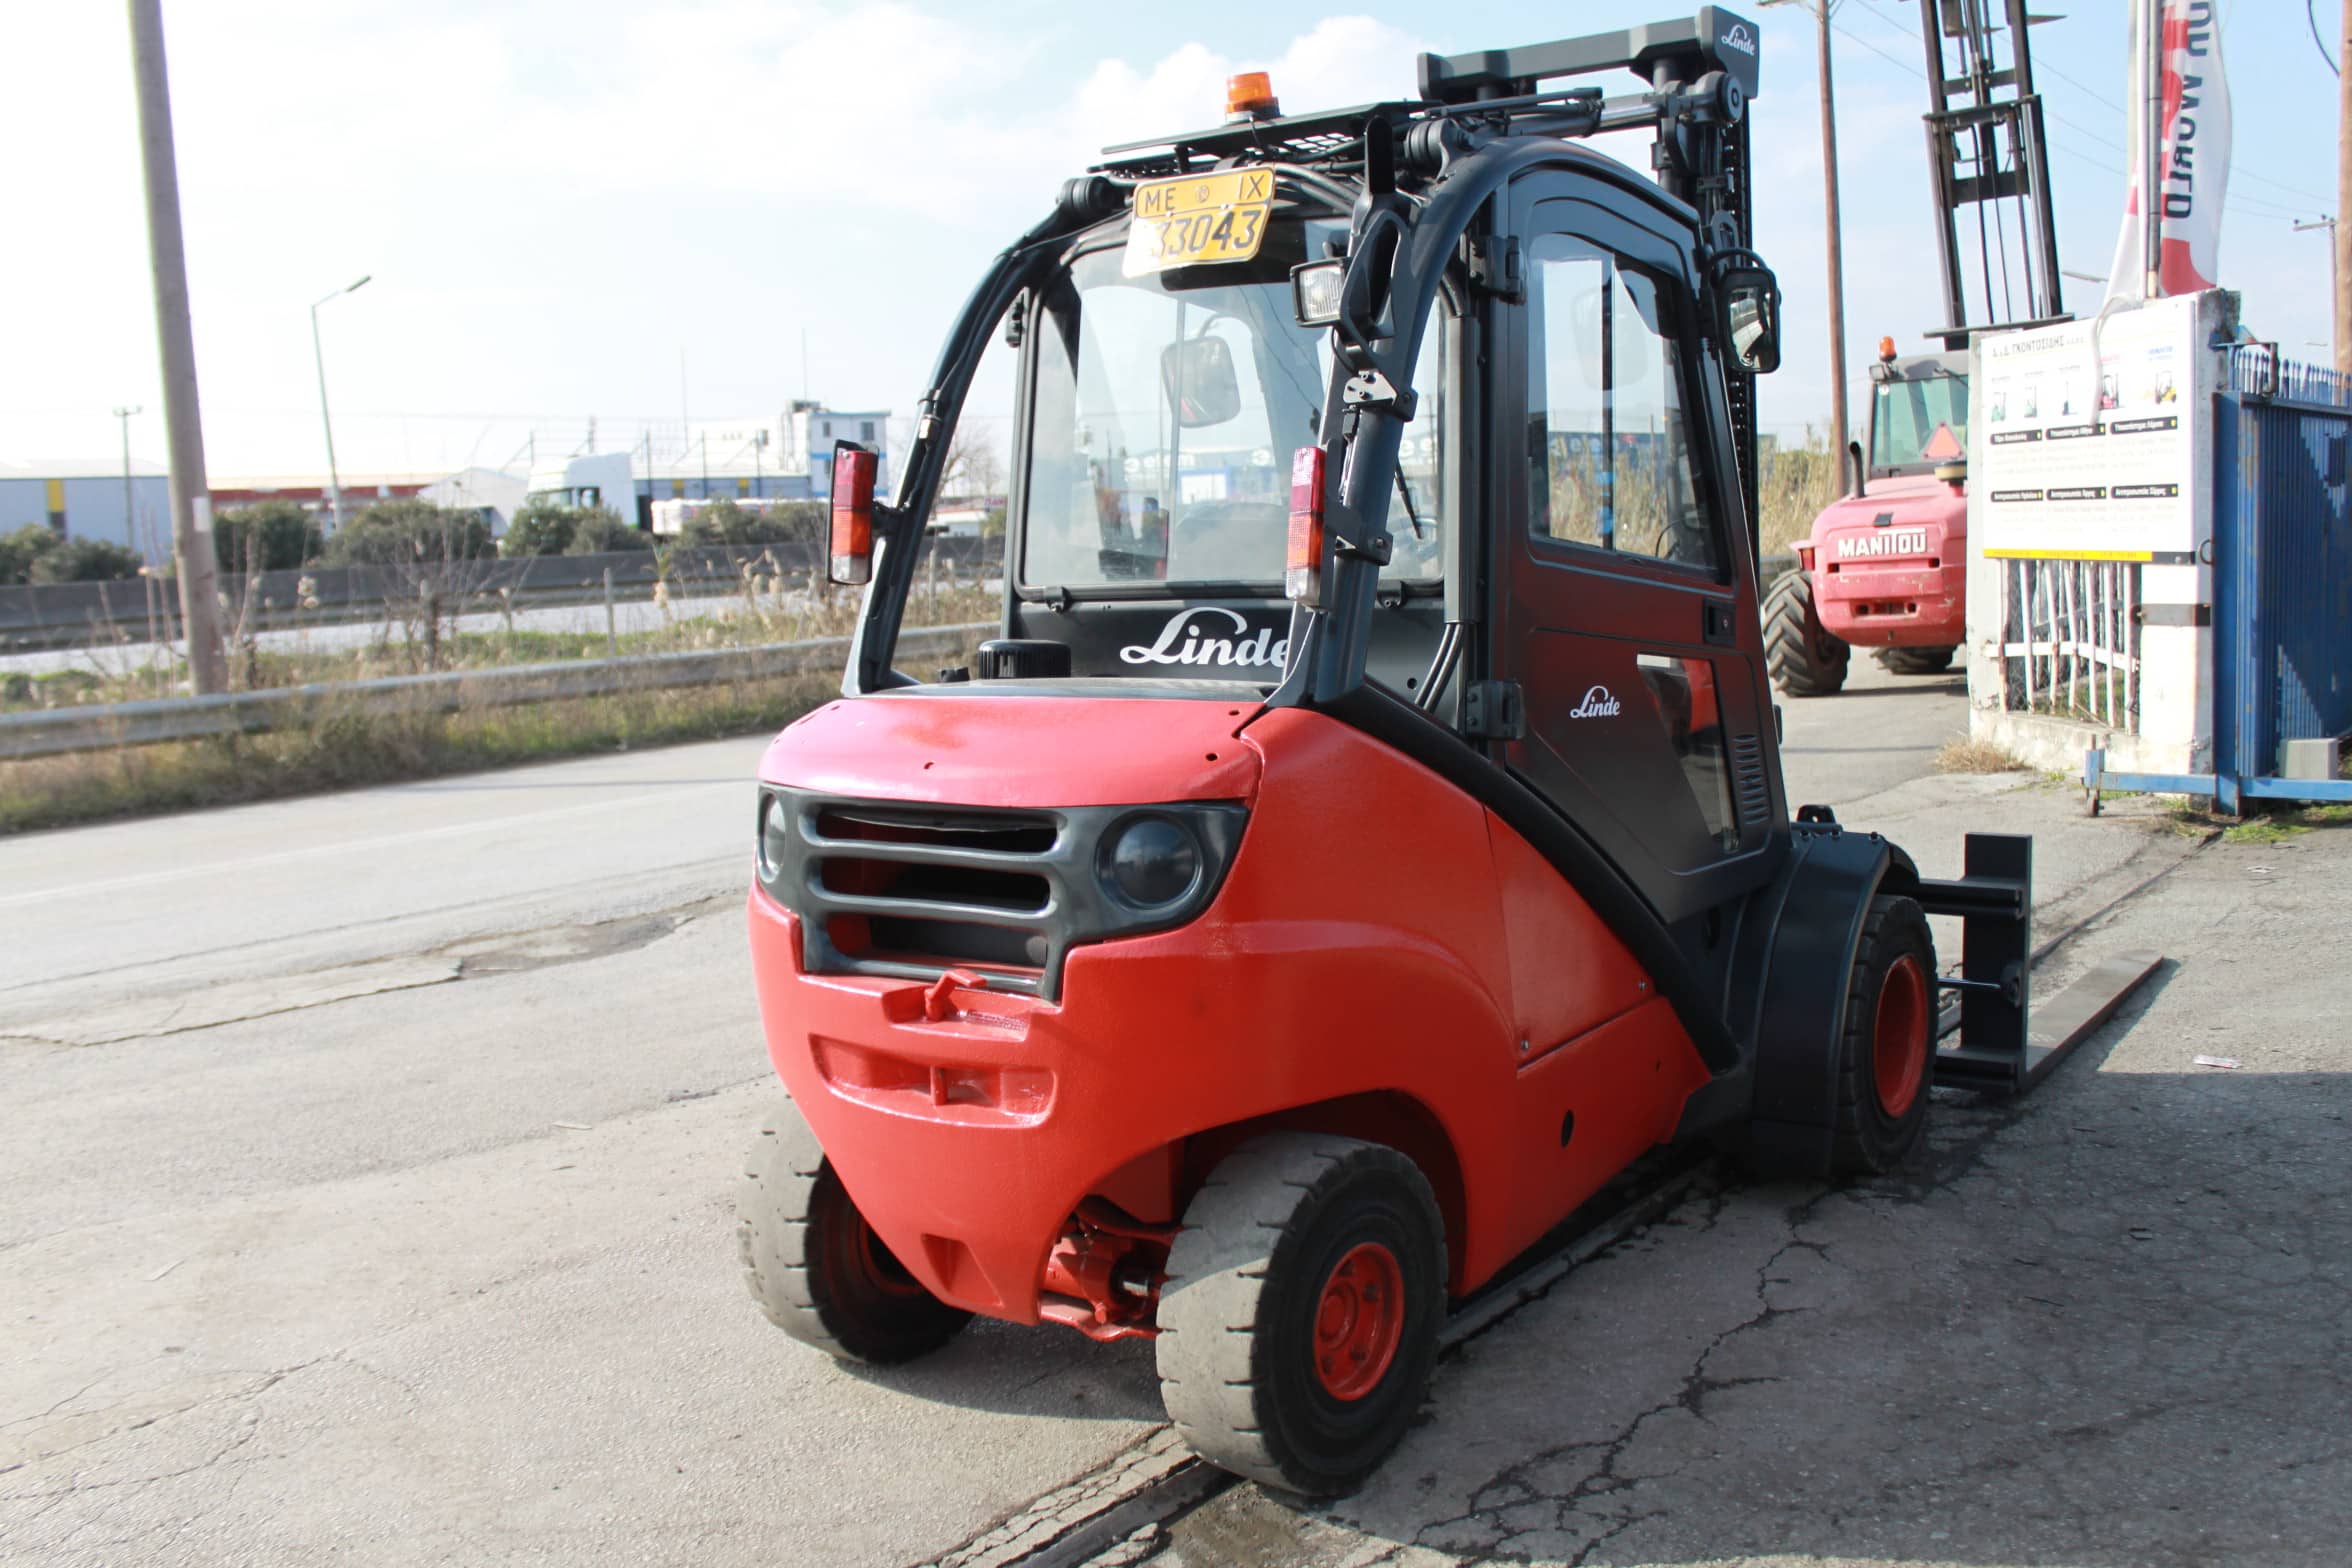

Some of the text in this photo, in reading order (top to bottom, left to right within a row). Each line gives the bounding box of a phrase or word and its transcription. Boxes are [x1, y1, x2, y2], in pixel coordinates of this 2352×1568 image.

[1721, 24, 1755, 56] Linde
[1145, 174, 1265, 214] ME IX
[1838, 527, 1925, 557] MANITOU
[1119, 606, 1289, 668] Linde
[1570, 685, 1620, 718] Linde
